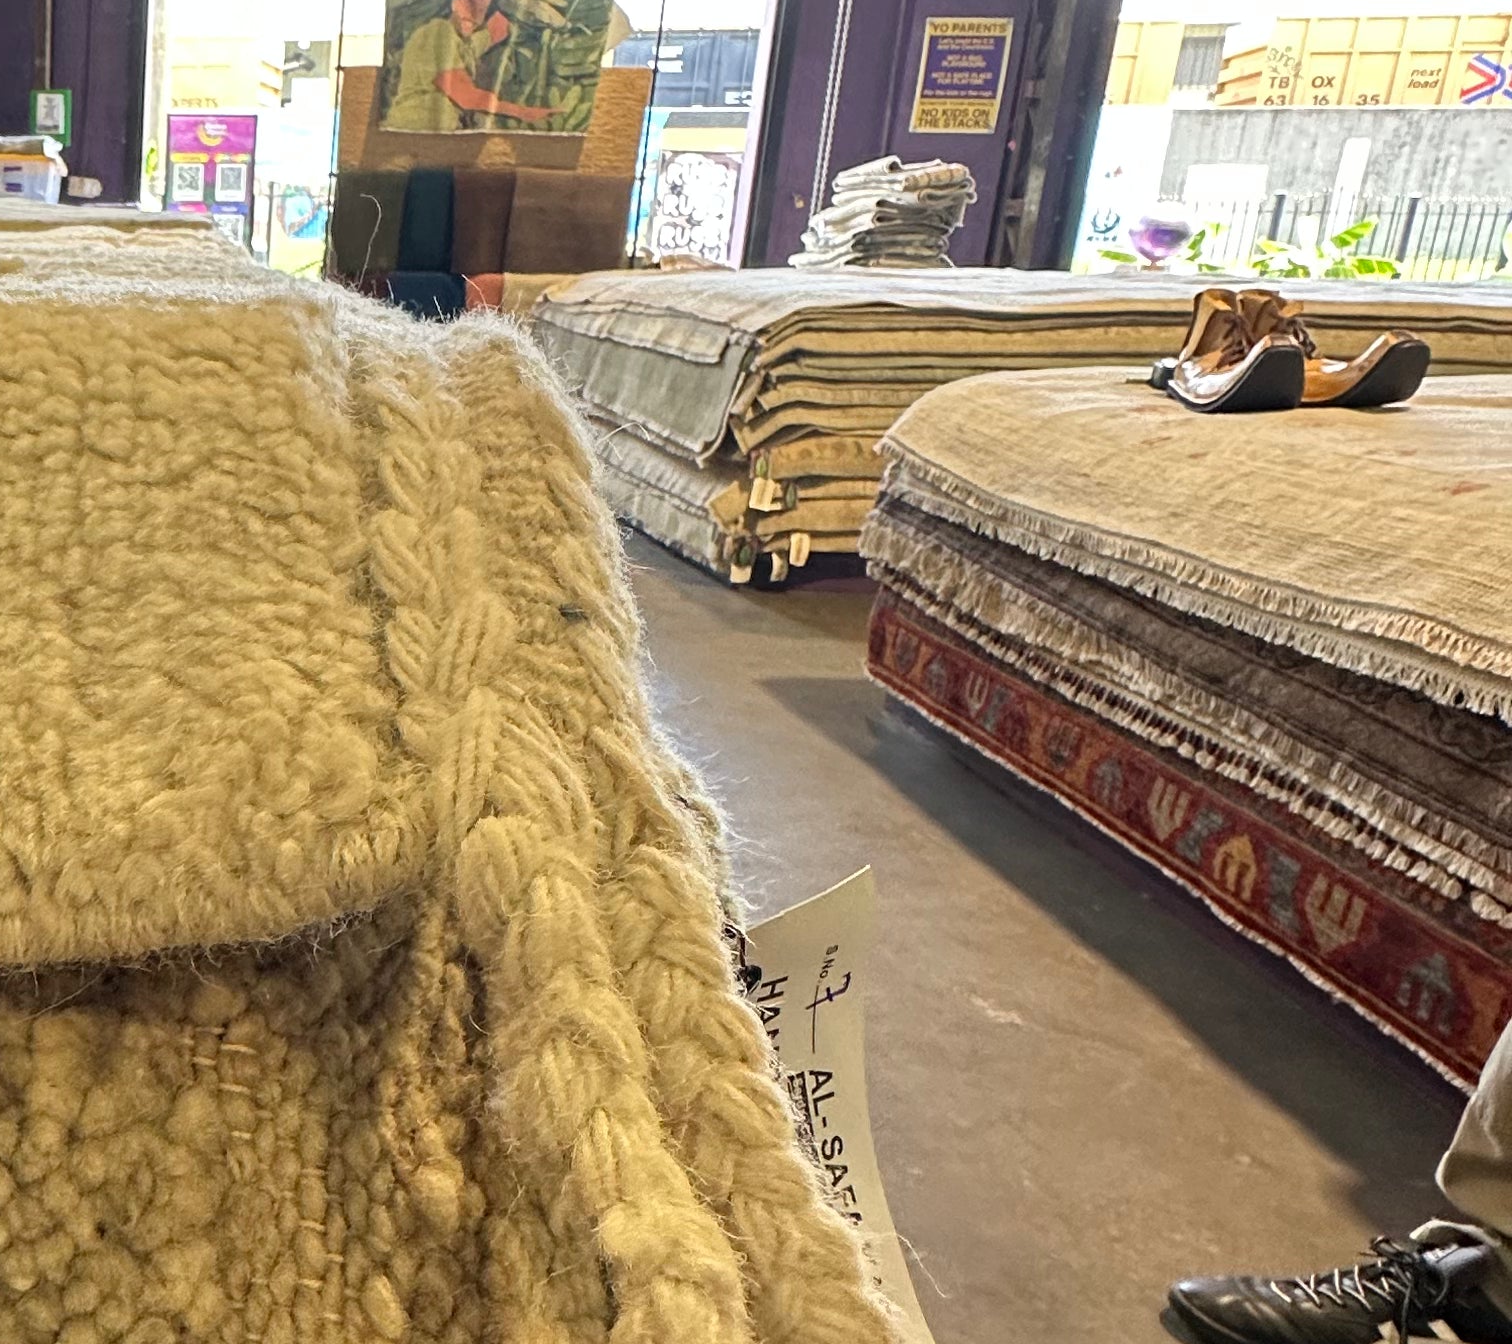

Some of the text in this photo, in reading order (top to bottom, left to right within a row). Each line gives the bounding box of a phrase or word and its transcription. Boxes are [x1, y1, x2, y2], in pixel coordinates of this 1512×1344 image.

[931, 22, 1008, 34] YO PARENTS
[1268, 76, 1336, 89] TB OX
[1263, 94, 1381, 106] 63 16 35
[921, 108, 991, 117] NO KIDS ON
[918, 118, 940, 128] THE
